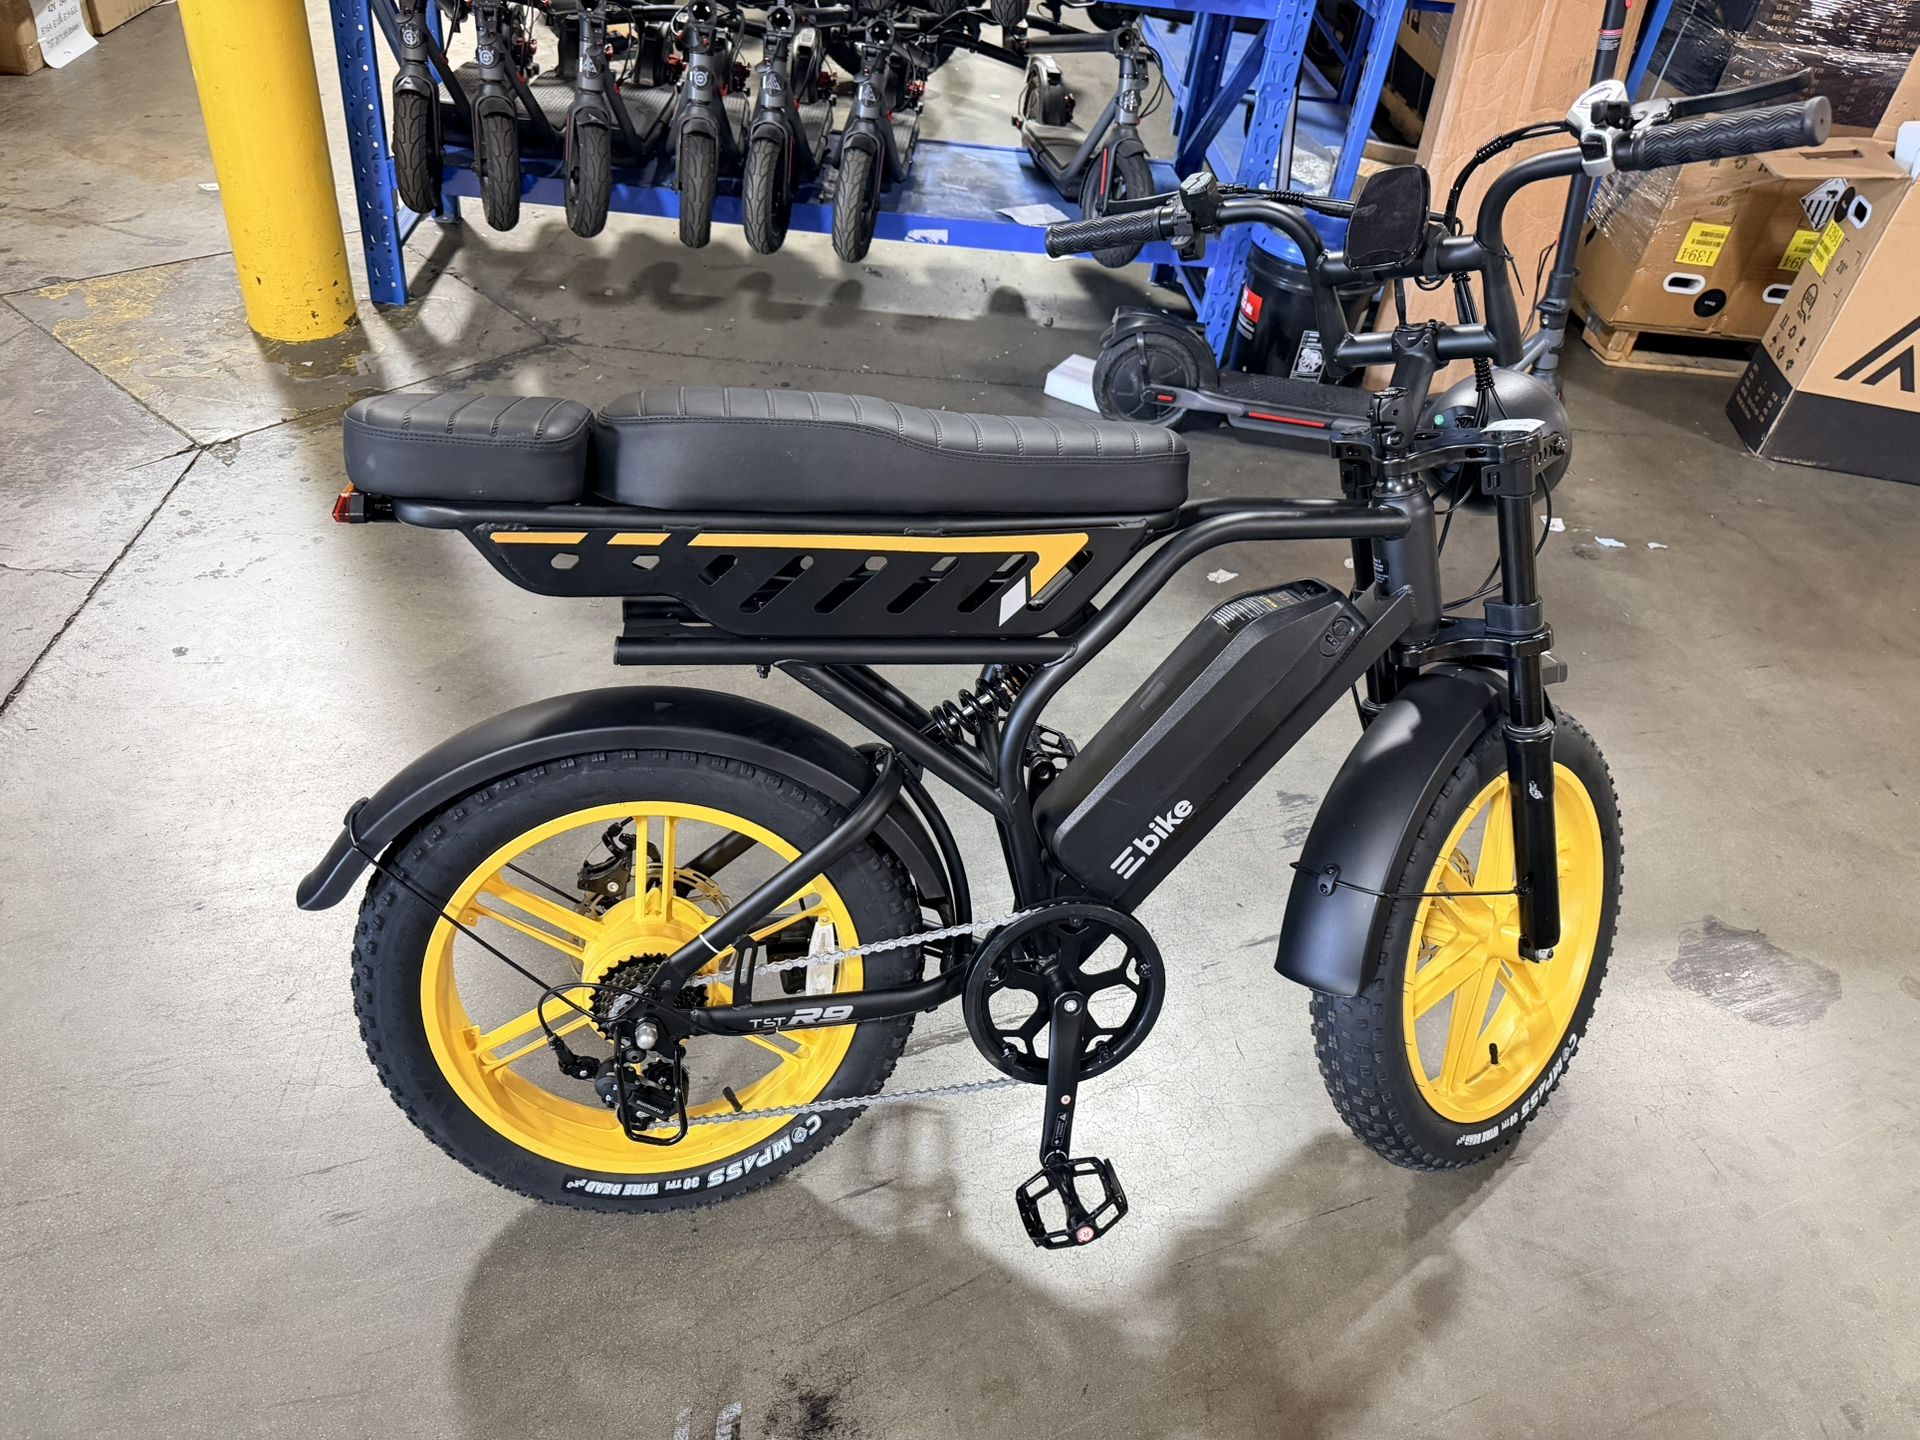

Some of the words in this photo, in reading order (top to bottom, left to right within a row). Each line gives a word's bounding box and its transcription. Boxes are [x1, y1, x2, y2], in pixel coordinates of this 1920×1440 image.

[1679, 247, 1715, 264] 1394
[749, 1016, 787, 1029] TST
[788, 1005, 855, 1026] R9
[707, 1114, 823, 1189] COMPASS
[584, 1180, 623, 1196] BEAD
[622, 1182, 659, 1196] WIRE
